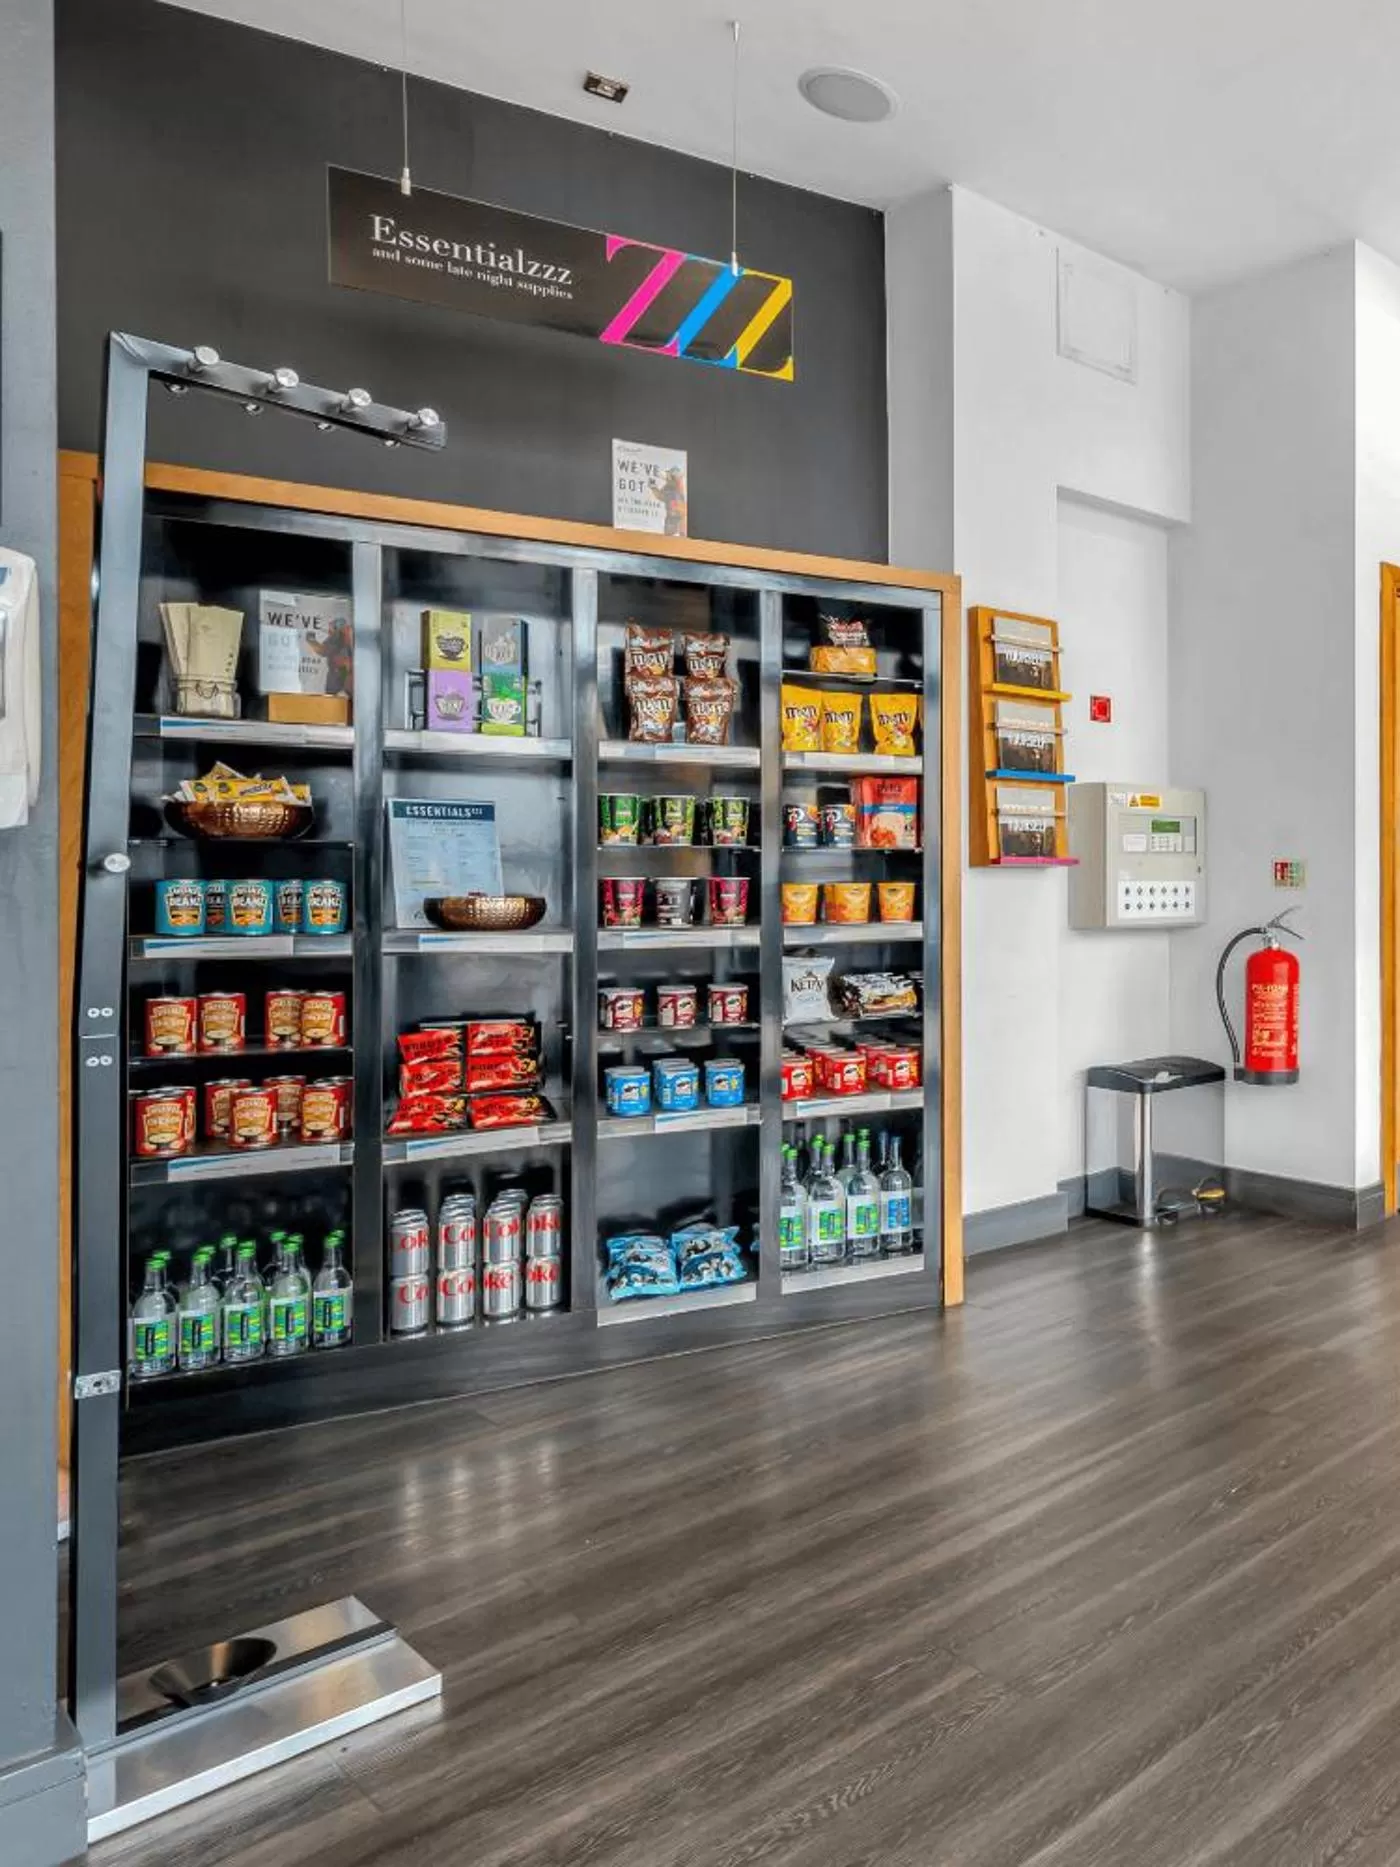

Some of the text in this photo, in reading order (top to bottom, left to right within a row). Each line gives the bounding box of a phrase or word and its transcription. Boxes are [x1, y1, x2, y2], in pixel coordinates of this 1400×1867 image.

[369, 214, 573, 285] Essentialzzz
[372, 247, 574, 300] and some late night supplies
[267, 612, 321, 630] WE'VE
